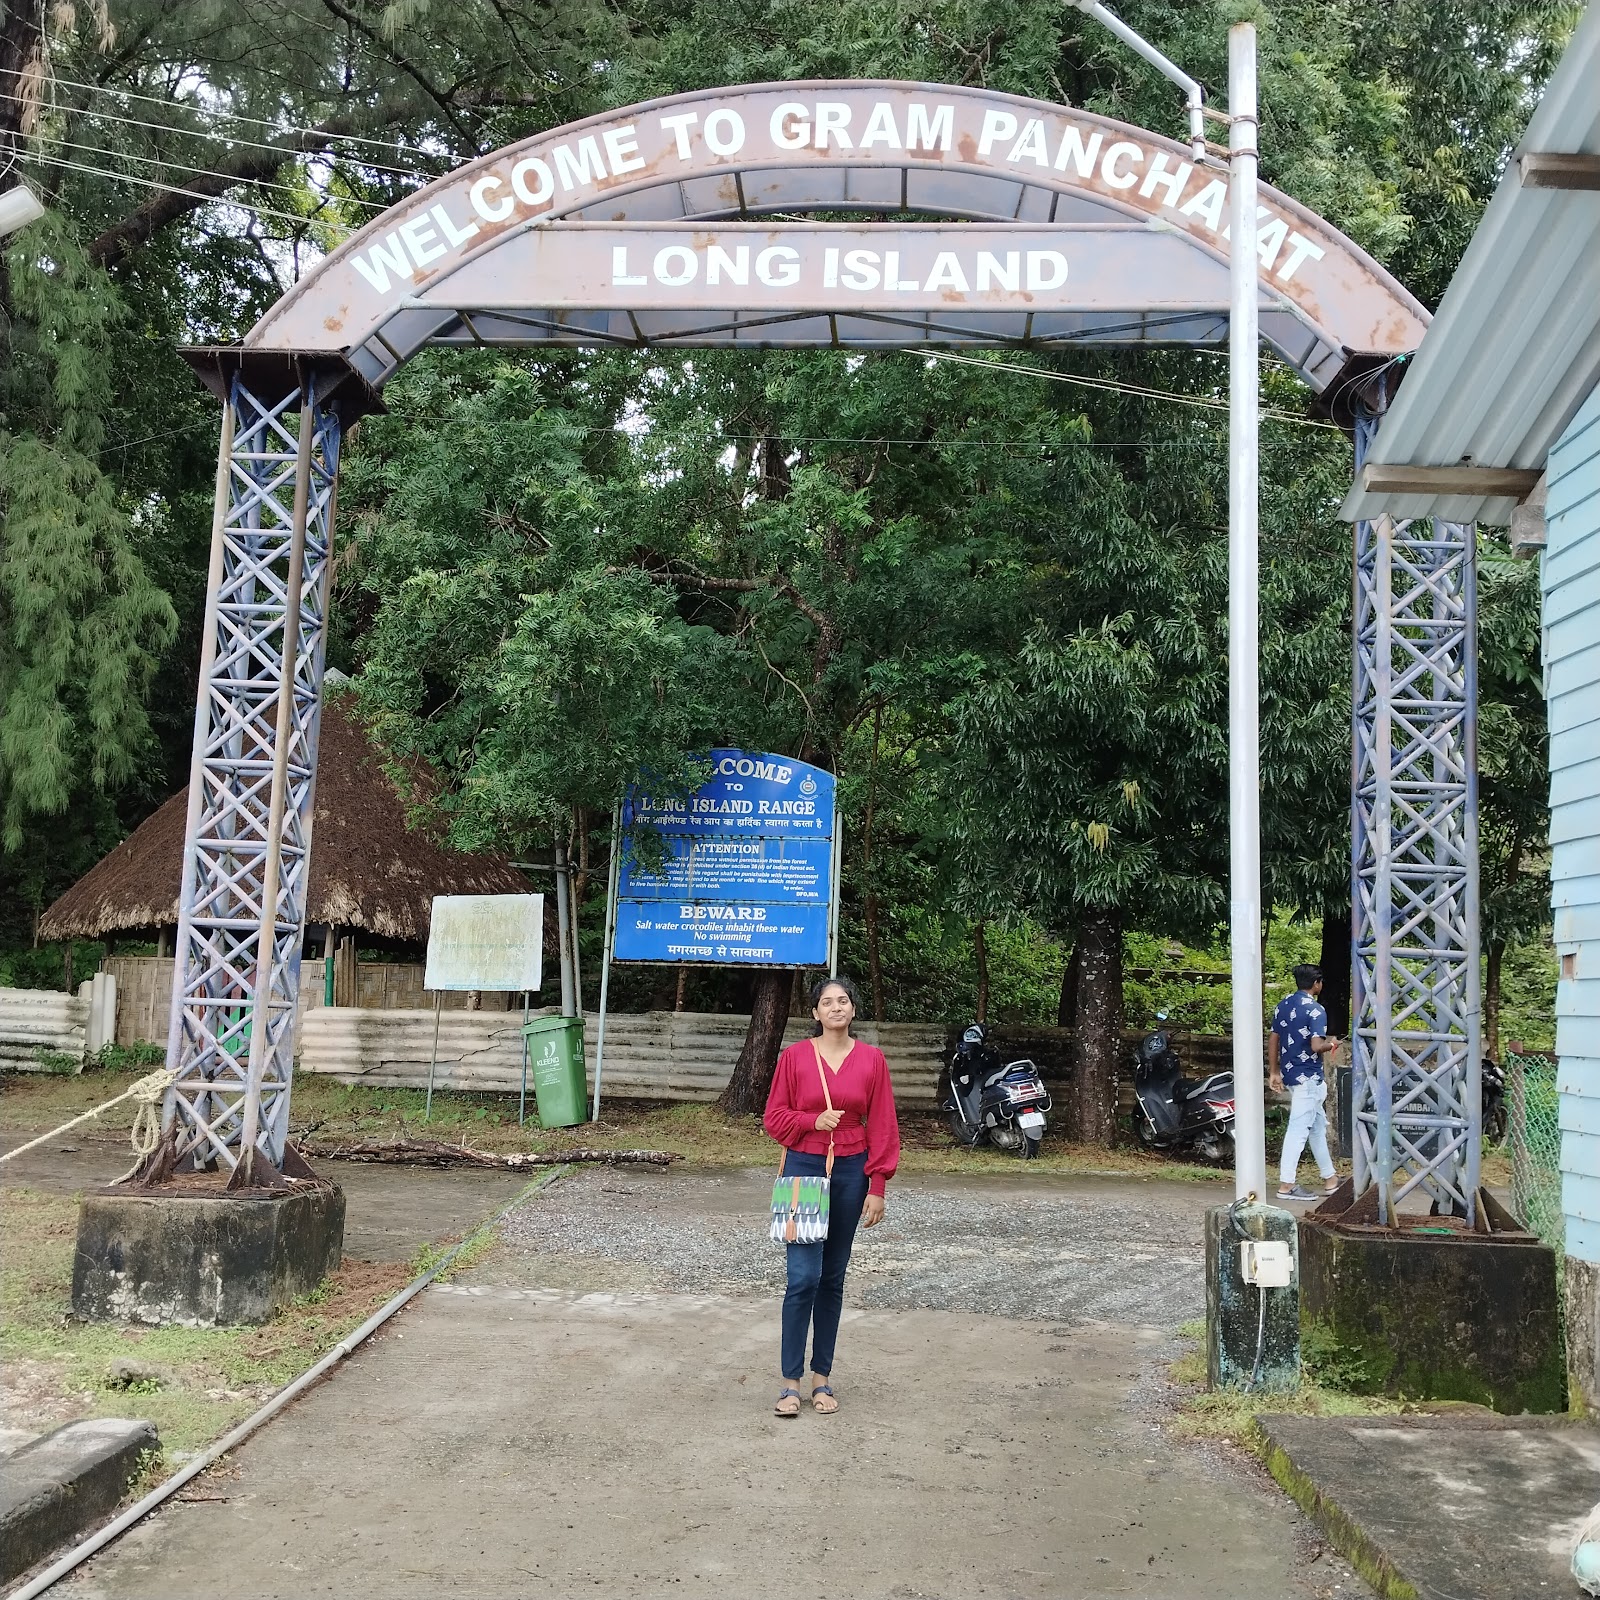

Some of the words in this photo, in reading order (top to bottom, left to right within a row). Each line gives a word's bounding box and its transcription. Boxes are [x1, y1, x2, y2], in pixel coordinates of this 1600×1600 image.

[350, 124, 647, 295] WELCOME
[660, 108, 746, 161] TO
[769, 102, 955, 151] GRAM
[612, 245, 801, 287] LONG
[823, 247, 1069, 291] ISLAND
[725, 783, 744, 791] TO
[641, 797, 686, 812] LONG
[692, 799, 753, 814] ISLAND
[758, 801, 815, 815] RANGE
[693, 843, 760, 854] ATTENTION
[679, 905, 767, 920] BEWARE
[635, 920, 652, 930] Salt
[655, 921, 679, 931] water
[681, 921, 723, 933] crocodiles
[725, 922, 755, 932] inhabit
[755, 922, 778, 933] these
[780, 925, 804, 934] water
[694, 932, 707, 941] No
[709, 932, 752, 943] swimming
[667, 945, 713, 957] मगरमच्छ
[717, 943, 727, 957] से
[730, 947, 773, 958] सावधान
